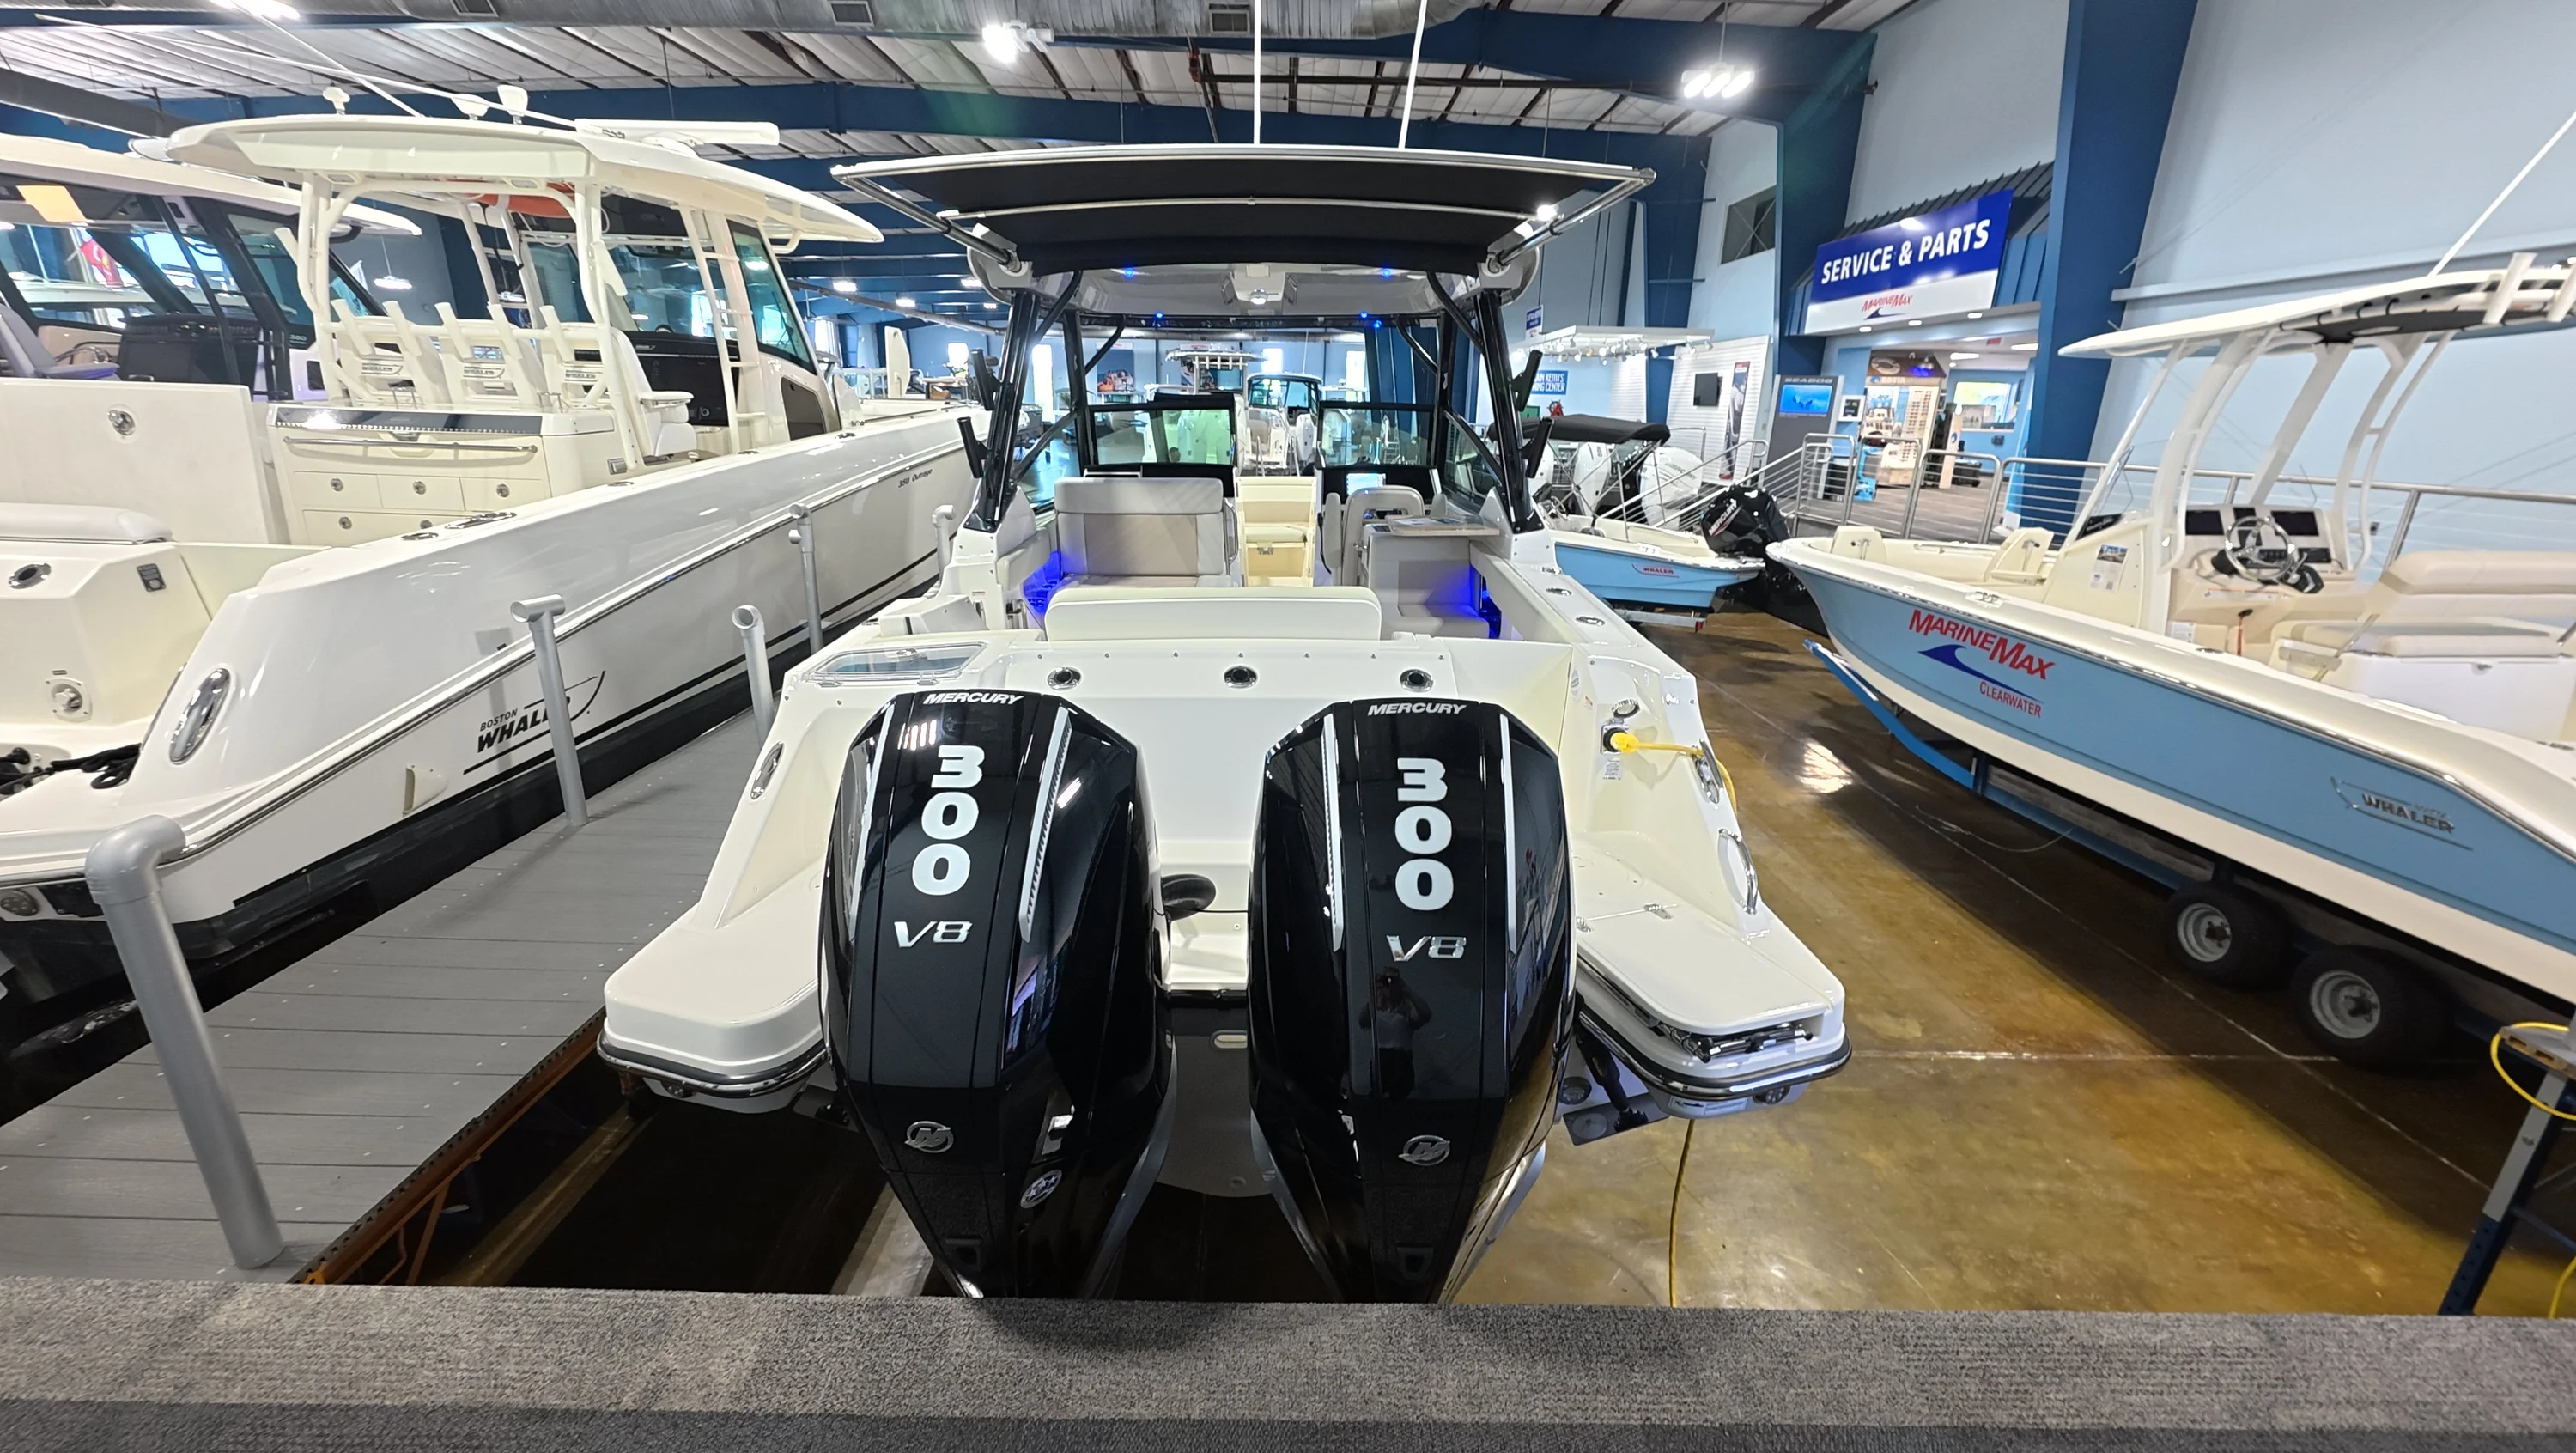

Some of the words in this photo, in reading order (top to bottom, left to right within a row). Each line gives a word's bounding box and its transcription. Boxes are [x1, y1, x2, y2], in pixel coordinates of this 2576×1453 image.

[1821, 245, 1893, 284] SERVICE
[1899, 240, 1913, 267] &
[1918, 219, 1990, 262] PARTS
[1709, 498, 1737, 536] MERCURY
[923, 692, 1024, 704] MERCURY
[1367, 702, 1467, 715] MERCURY
[1979, 681, 2042, 718] CLEARWATER
[477, 696, 570, 753] WHAL
[480, 708, 518, 732] BOSTON
[912, 745, 985, 896] 300
[2362, 793, 2455, 834] WHALER
[1394, 757, 1454, 911] 300
[894, 921, 973, 948] V8
[1386, 934, 1467, 962] V8
